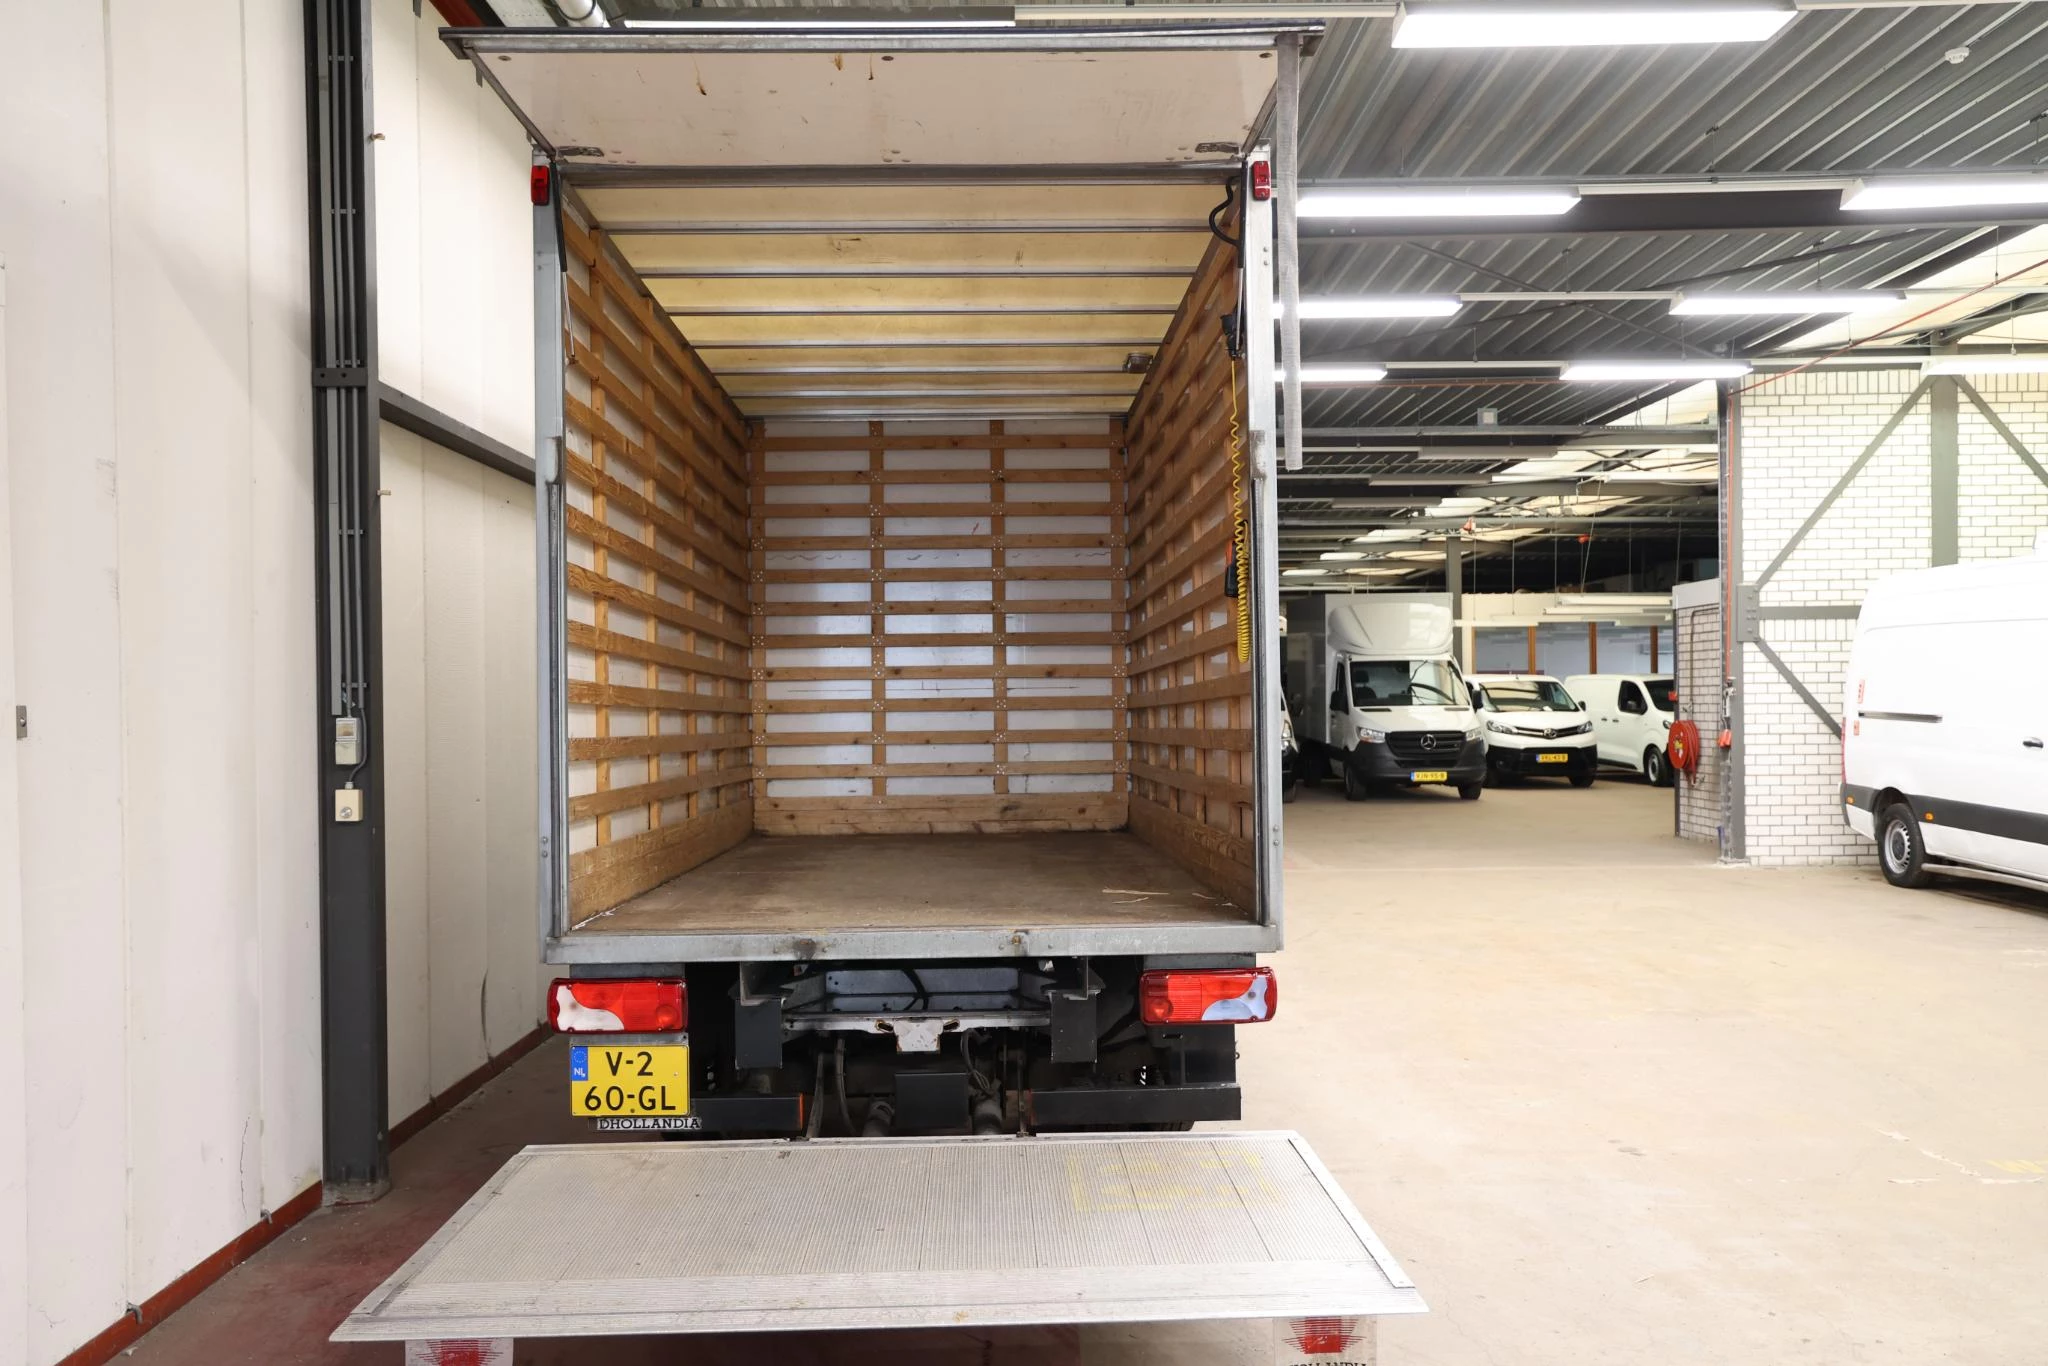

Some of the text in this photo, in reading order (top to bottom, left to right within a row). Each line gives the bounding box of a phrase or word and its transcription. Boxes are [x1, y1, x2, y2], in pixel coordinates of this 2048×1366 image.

[574, 1067, 586, 1077] NL
[605, 1051, 654, 1077] V-2
[584, 1085, 677, 1111] 60-GL
[599, 1117, 702, 1130] DHOLLANDIA
